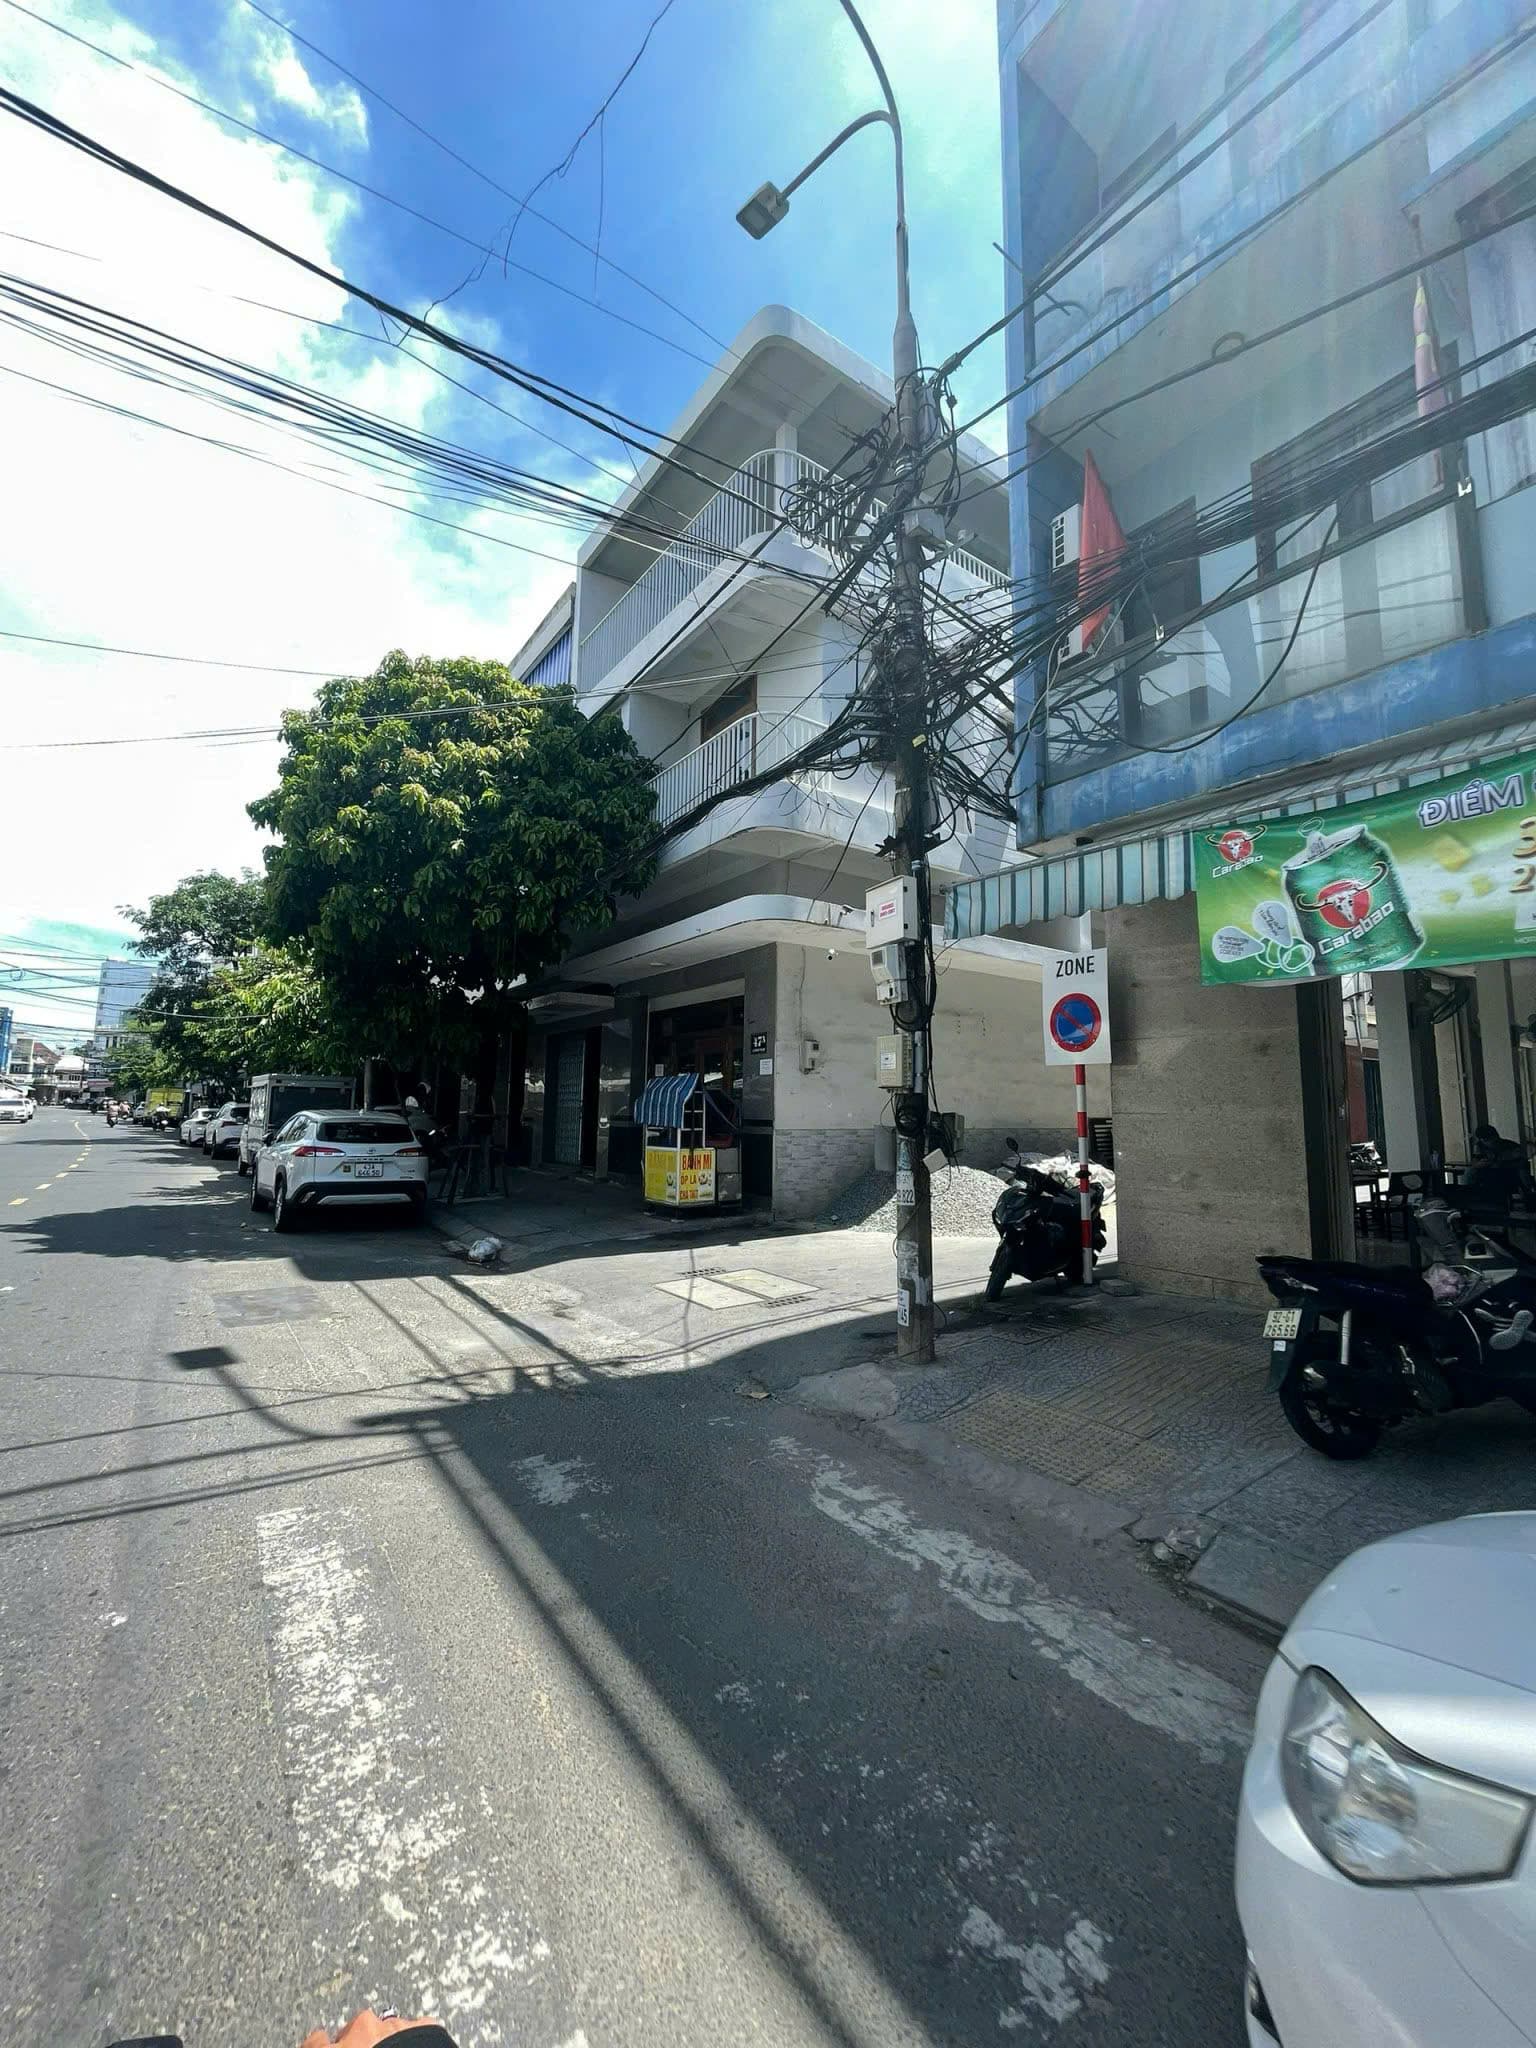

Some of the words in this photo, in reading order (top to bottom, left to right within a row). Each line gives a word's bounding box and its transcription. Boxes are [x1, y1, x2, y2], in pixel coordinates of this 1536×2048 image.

[1212, 855, 1263, 878] Carabao
[1317, 901, 1395, 955] Carabao
[1056, 955, 1095, 978] ZONE
